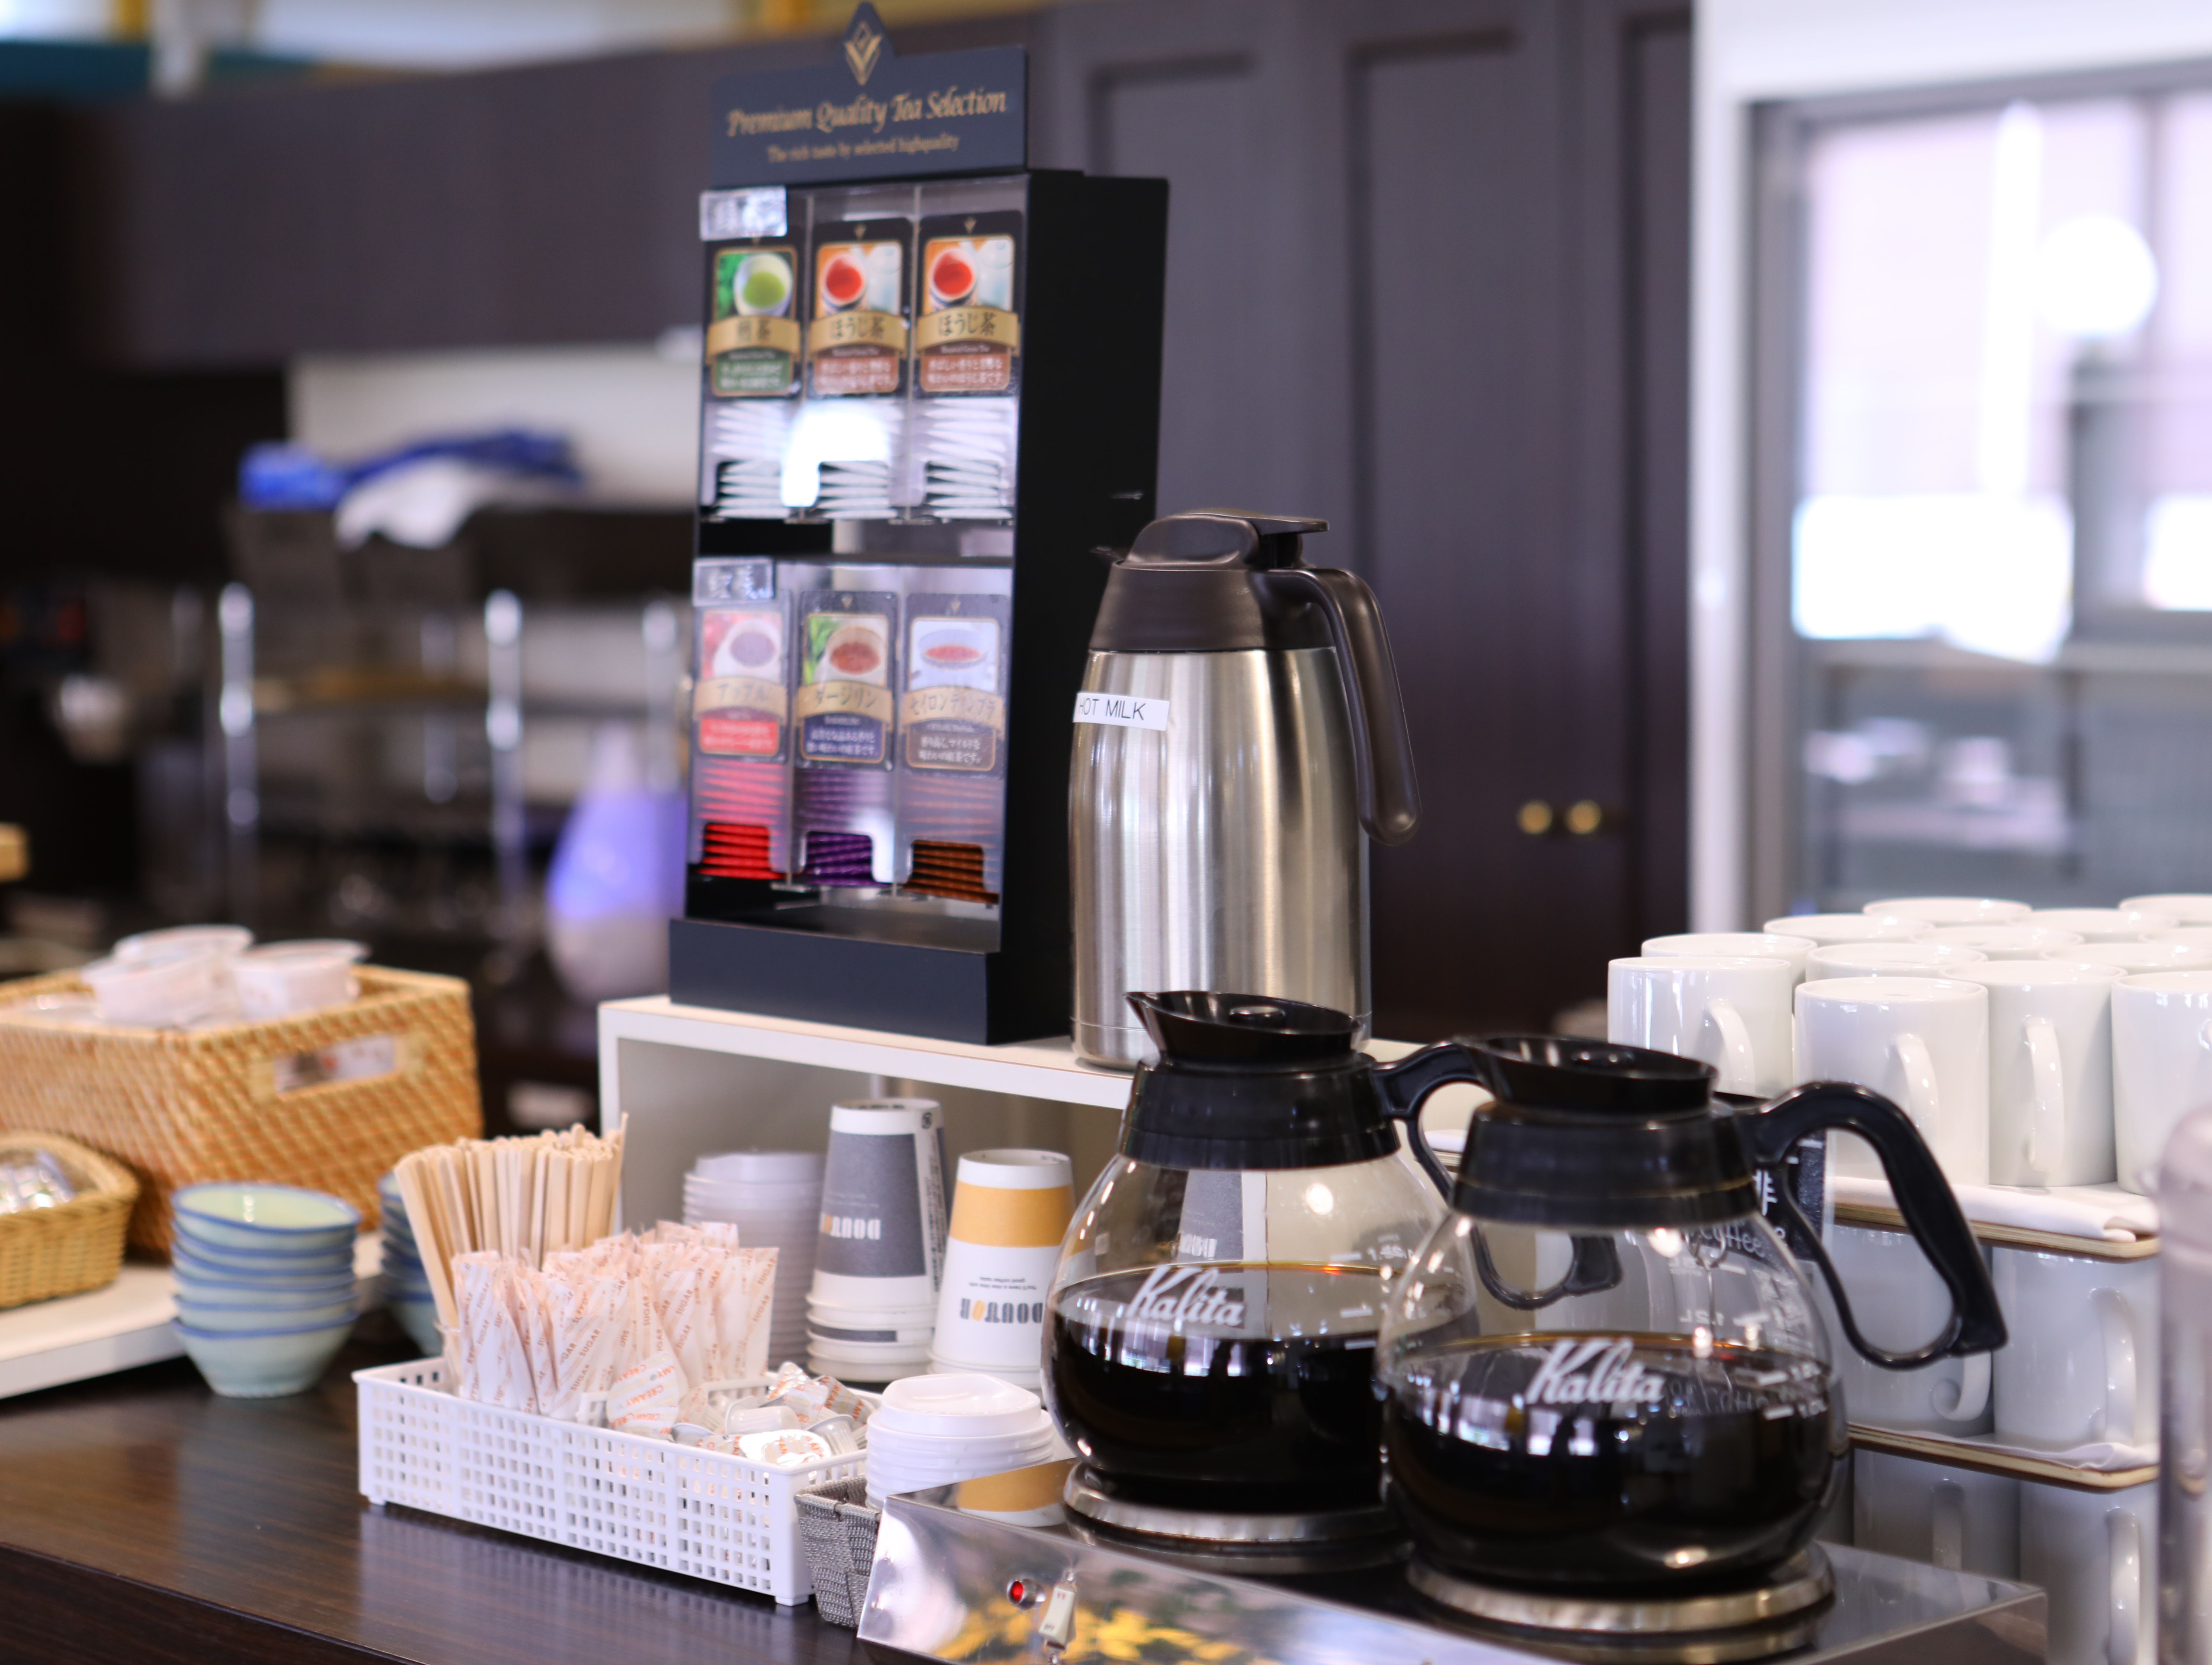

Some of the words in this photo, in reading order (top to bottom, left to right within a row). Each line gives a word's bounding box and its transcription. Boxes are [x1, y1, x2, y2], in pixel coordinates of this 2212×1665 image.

[727, 109, 812, 136] Premium
[817, 94, 887, 133] Quality
[892, 91, 922, 122] Tea
[926, 86, 1006, 119] Selection
[831, 314, 885, 340] ほうじ茶
[939, 312, 996, 336] ほうじ茶
[816, 685, 877, 708] ダージリン
[1079, 698, 1100, 715] HOT
[1105, 699, 1146, 721] MILK
[758, 1258, 777, 1286] SUGAR
[476, 1283, 490, 1309] SUGAR
[676, 1289, 693, 1316] SUGAR
[1125, 1265, 1244, 1326] Kalita
[752, 1295, 771, 1323] SUGAR
[960, 1298, 1042, 1324] DOUTOR
[477, 1319, 490, 1345] SUGAR
[579, 1329, 601, 1357] SUGAR
[620, 1330, 630, 1348] SUG
[675, 1324, 692, 1349] SUGAR
[571, 1364, 590, 1391] SUGAR
[1525, 1337, 1667, 1403] Kalita
[626, 1385, 664, 1407] CREAMY
